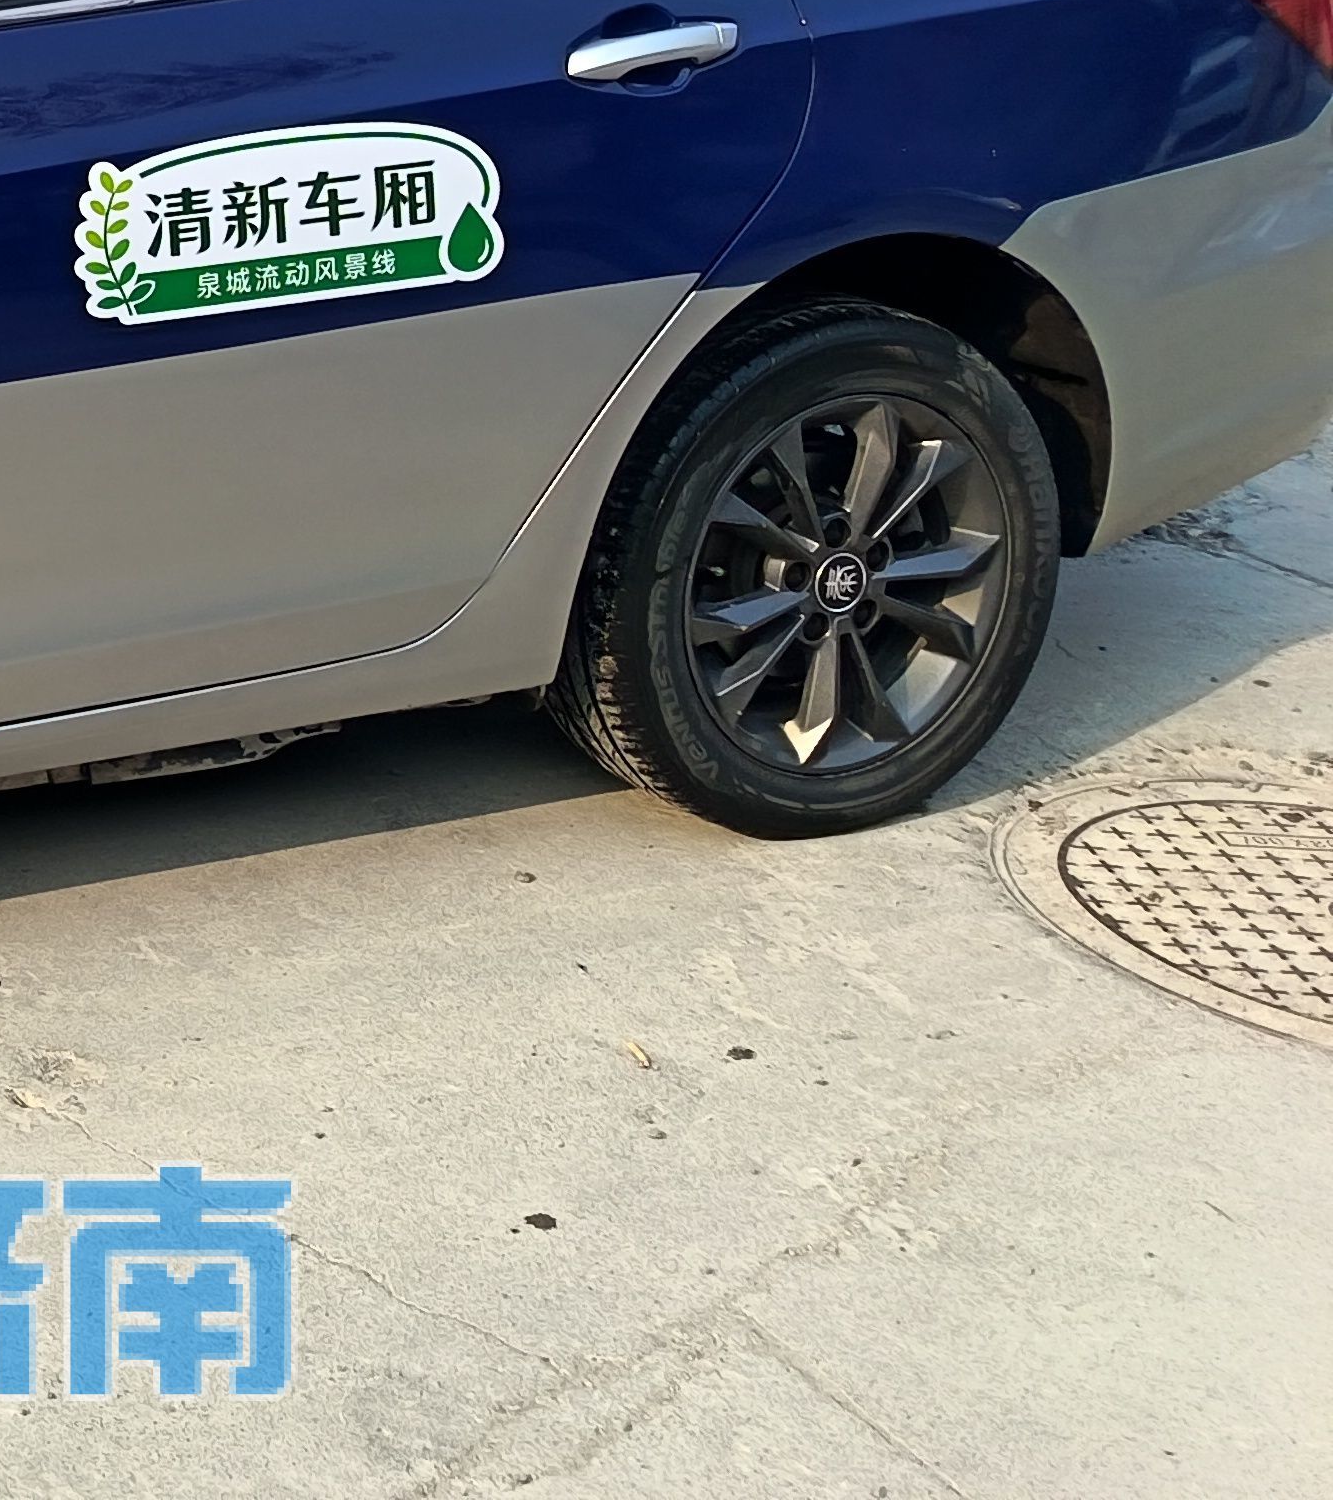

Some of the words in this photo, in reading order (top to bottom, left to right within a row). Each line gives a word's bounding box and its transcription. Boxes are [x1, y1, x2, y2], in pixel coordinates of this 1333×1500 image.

[144, 160, 436, 258] 清新车厢
[196, 250, 396, 299] 泉城流动风景线
